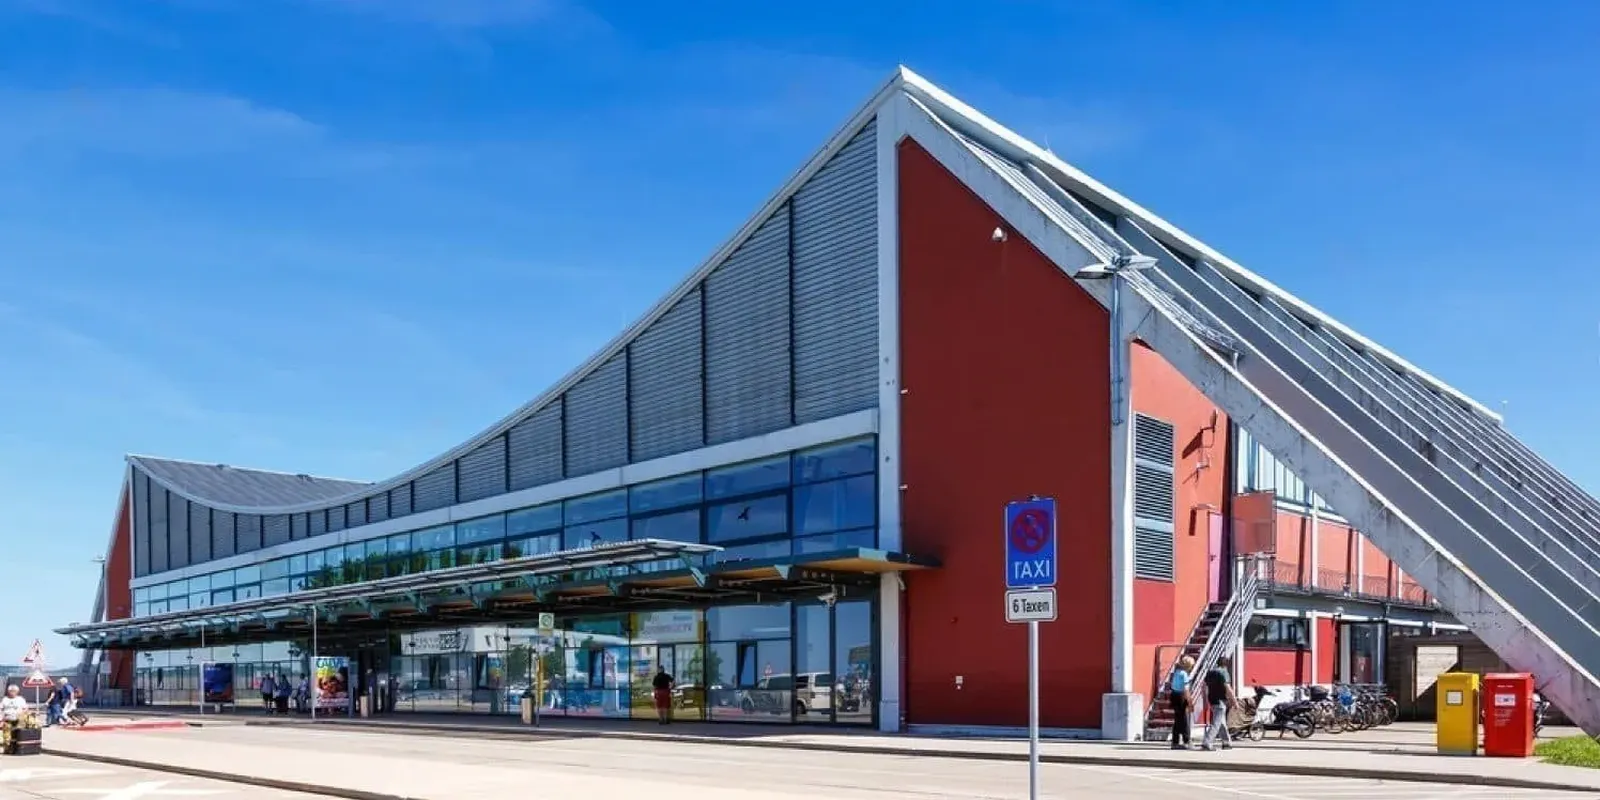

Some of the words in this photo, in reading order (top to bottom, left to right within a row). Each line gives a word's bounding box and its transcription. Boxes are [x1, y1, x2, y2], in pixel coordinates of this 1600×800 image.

[1014, 560, 1050, 579] TAXI
[1012, 599, 1019, 613] 6
[1021, 598, 1050, 613] Taxen
